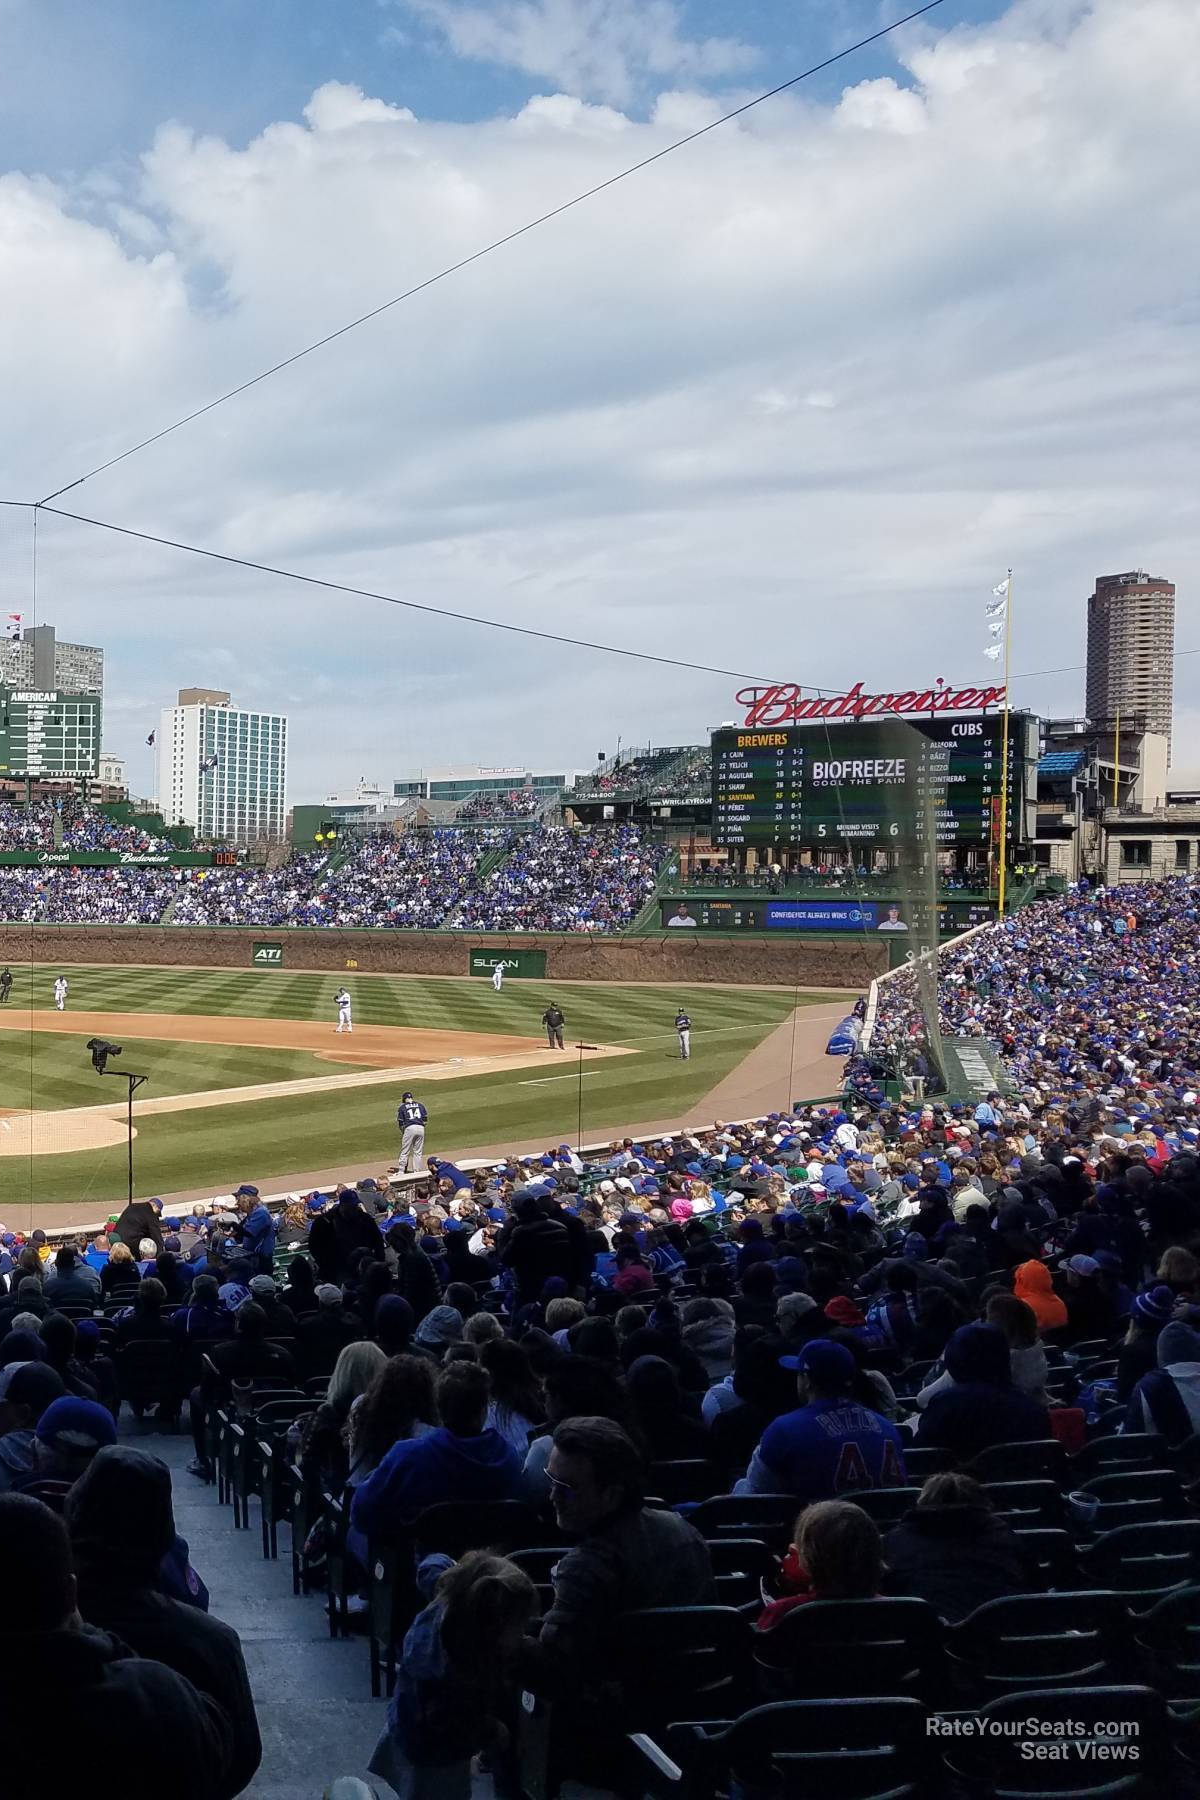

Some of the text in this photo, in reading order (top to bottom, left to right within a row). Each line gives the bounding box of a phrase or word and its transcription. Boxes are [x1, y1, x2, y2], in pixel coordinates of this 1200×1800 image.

[11, 692, 57, 701] AMERICAN
[736, 681, 1006, 727] Budweiser
[951, 723, 983, 736] CUBS
[737, 734, 788, 747] BREWERS
[813, 759, 905, 780] BIOFREEZE
[929, 775, 967, 783] CONTRERAS
[818, 824, 827, 837] 5
[889, 823, 899, 835] 6
[48, 853, 70, 861] pepsi
[120, 852, 170, 863] Budweiser
[216, 853, 237, 864] 0:06
[254, 949, 282, 959] ATI
[407, 1108, 421, 1120] 14
